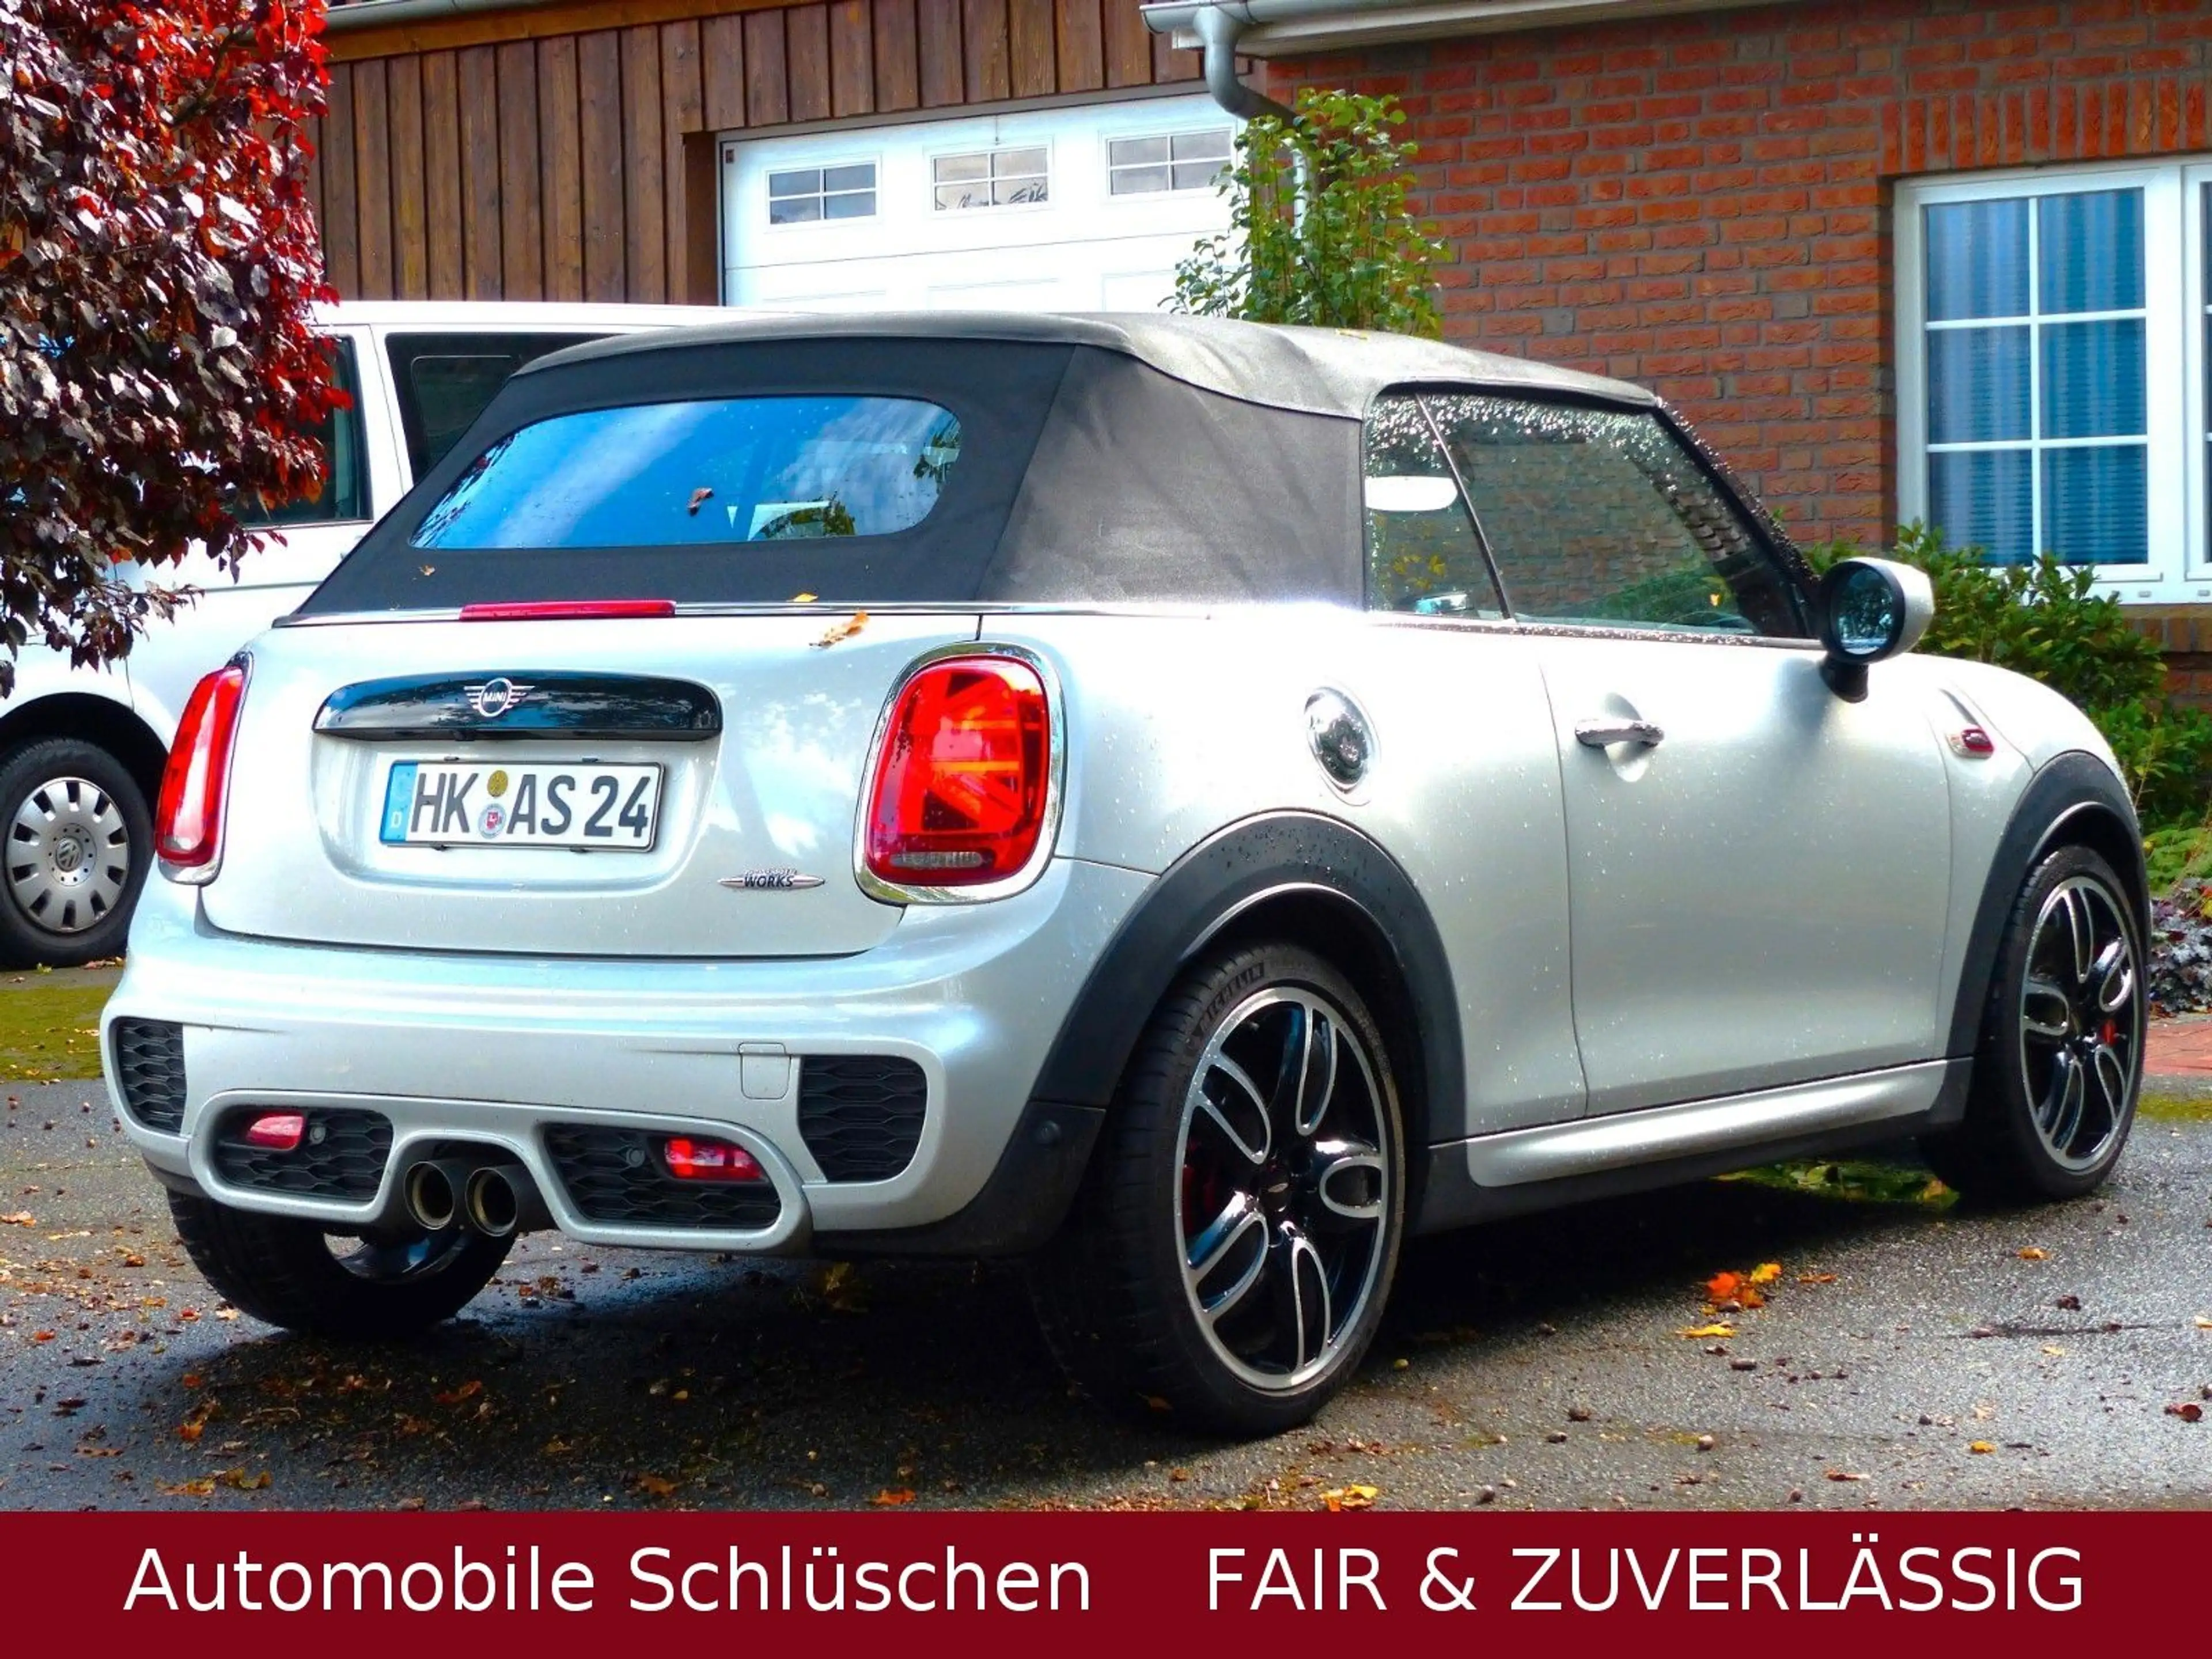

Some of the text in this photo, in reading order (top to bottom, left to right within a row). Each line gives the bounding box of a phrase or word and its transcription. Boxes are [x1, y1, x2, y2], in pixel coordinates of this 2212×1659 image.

[483, 691, 507, 702] MINI
[411, 772, 650, 838] HK AS 24
[744, 875, 794, 887] WORKS
